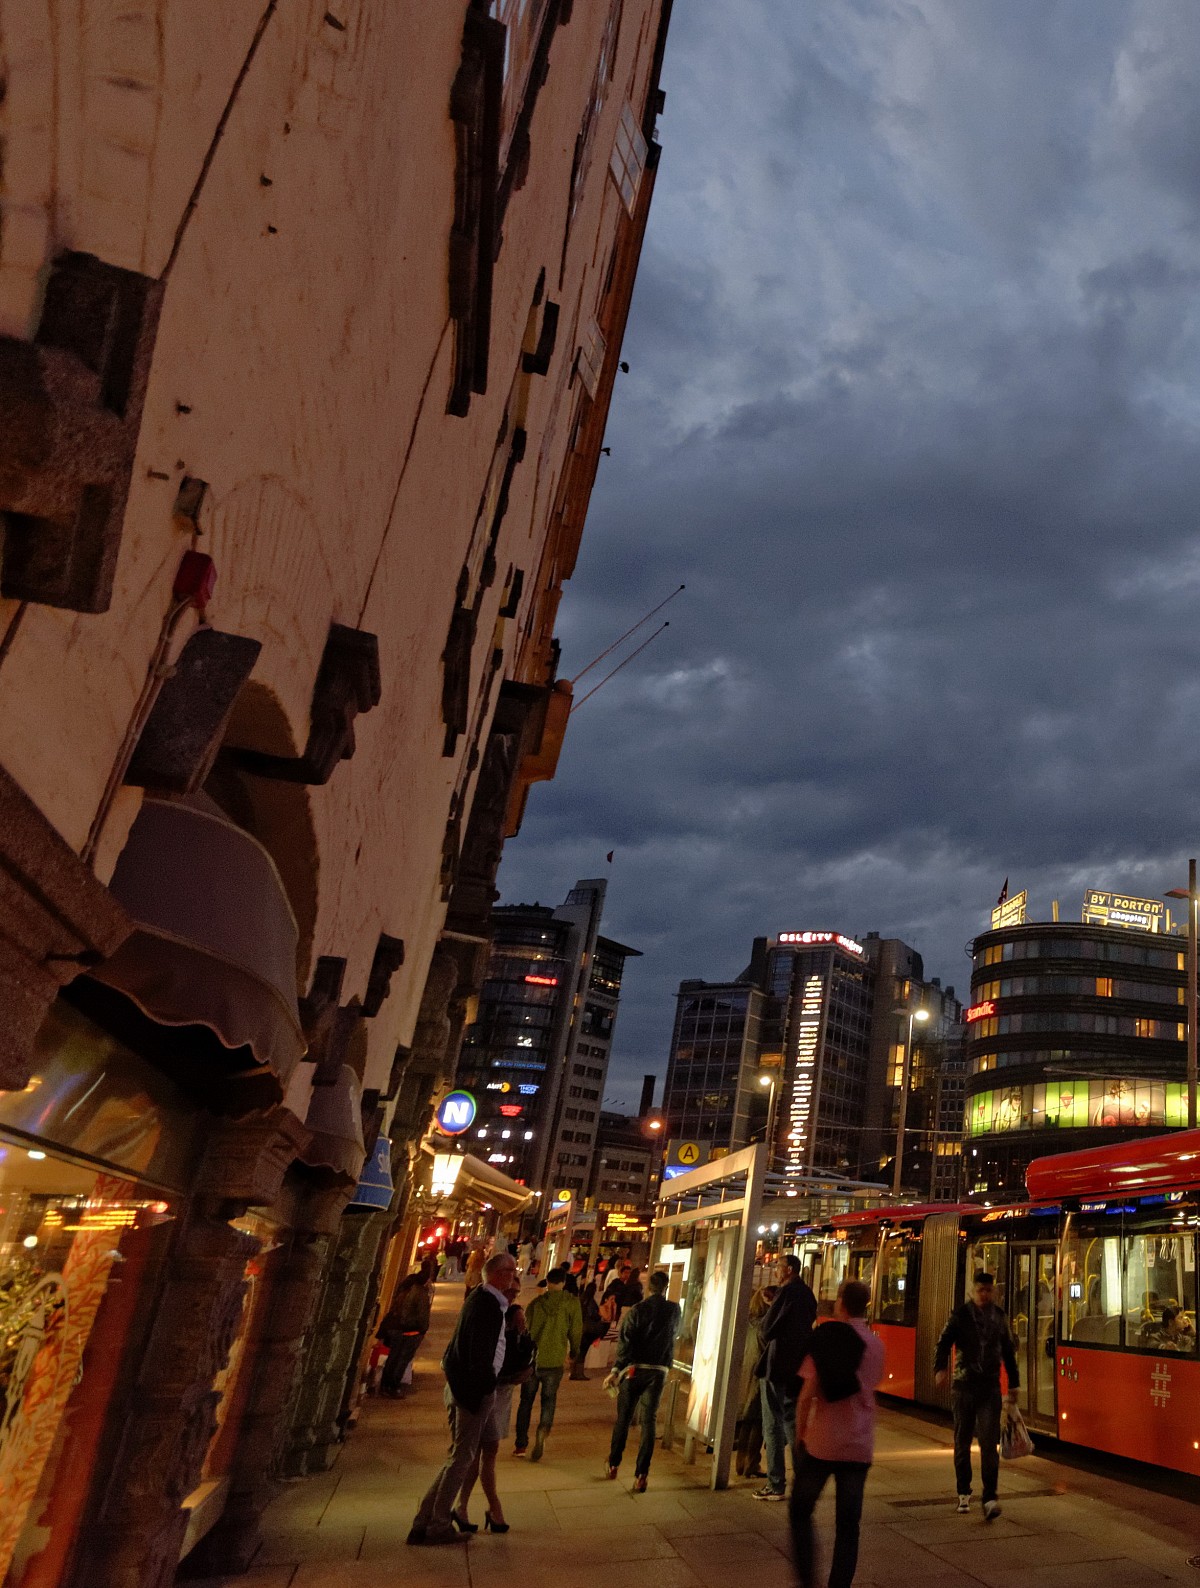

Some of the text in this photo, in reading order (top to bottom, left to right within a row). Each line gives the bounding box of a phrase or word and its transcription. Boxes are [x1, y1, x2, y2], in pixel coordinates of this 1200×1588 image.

[1110, 911, 1147, 925] shopping
[967, 1001, 995, 1022] Scandic
[442, 1101, 470, 1124] N
[682, 1145, 695, 1160] A
